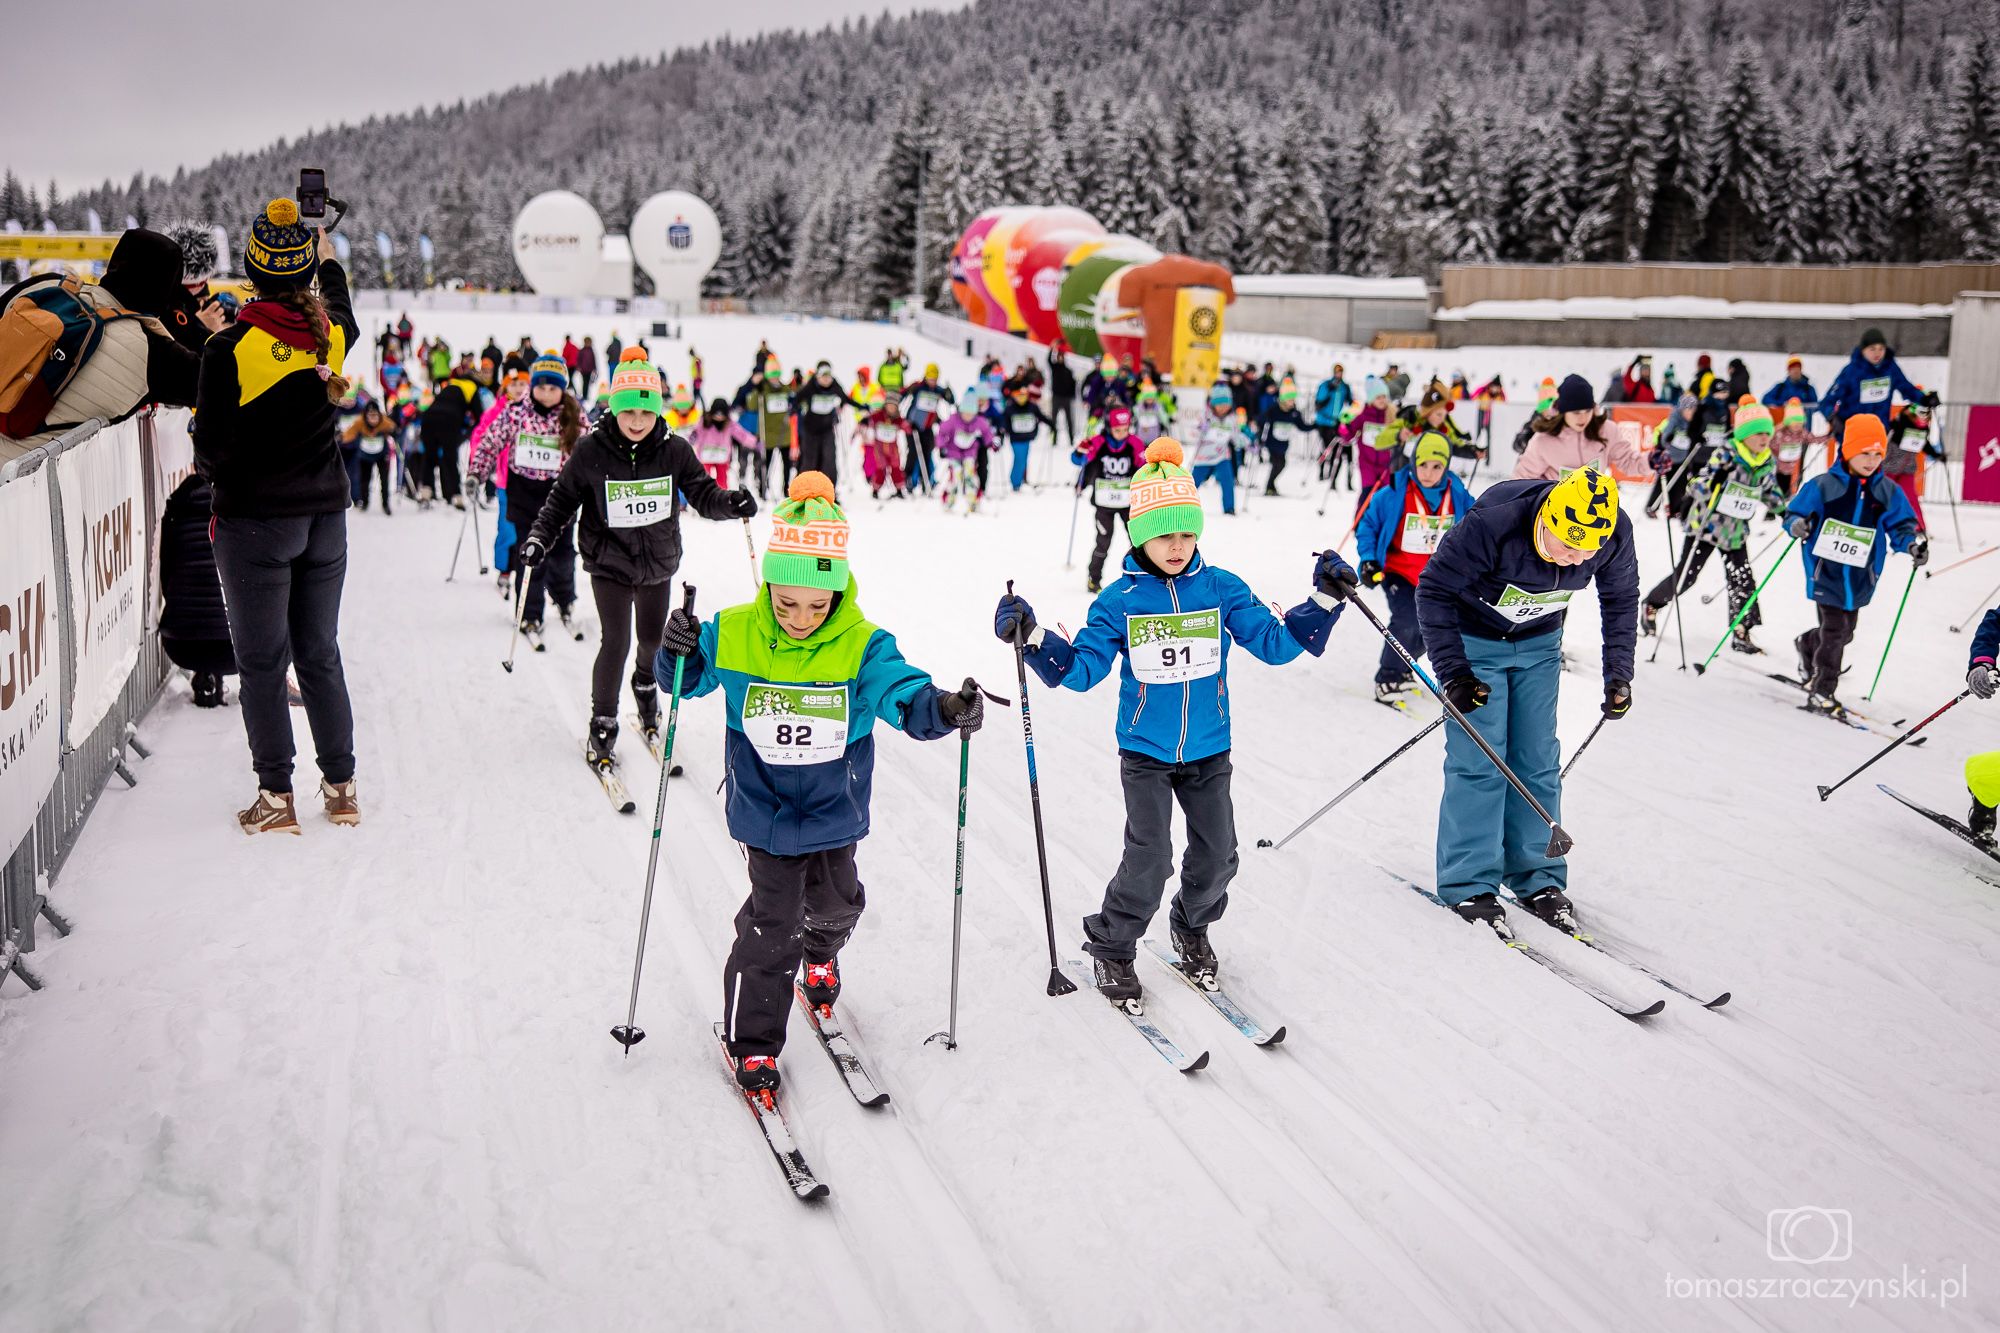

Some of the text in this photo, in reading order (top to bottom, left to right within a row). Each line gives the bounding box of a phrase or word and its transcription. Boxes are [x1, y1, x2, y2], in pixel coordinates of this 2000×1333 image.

[528, 450, 551, 461] 110
[624, 501, 657, 515] 109
[92, 497, 132, 603] KGHM
[1833, 540, 1858, 555] 106
[1516, 607, 1544, 617] 92
[1161, 646, 1191, 667] 91
[801, 694, 817, 705] 49
[776, 724, 812, 746] 82
[0, 728, 25, 776] SKA
